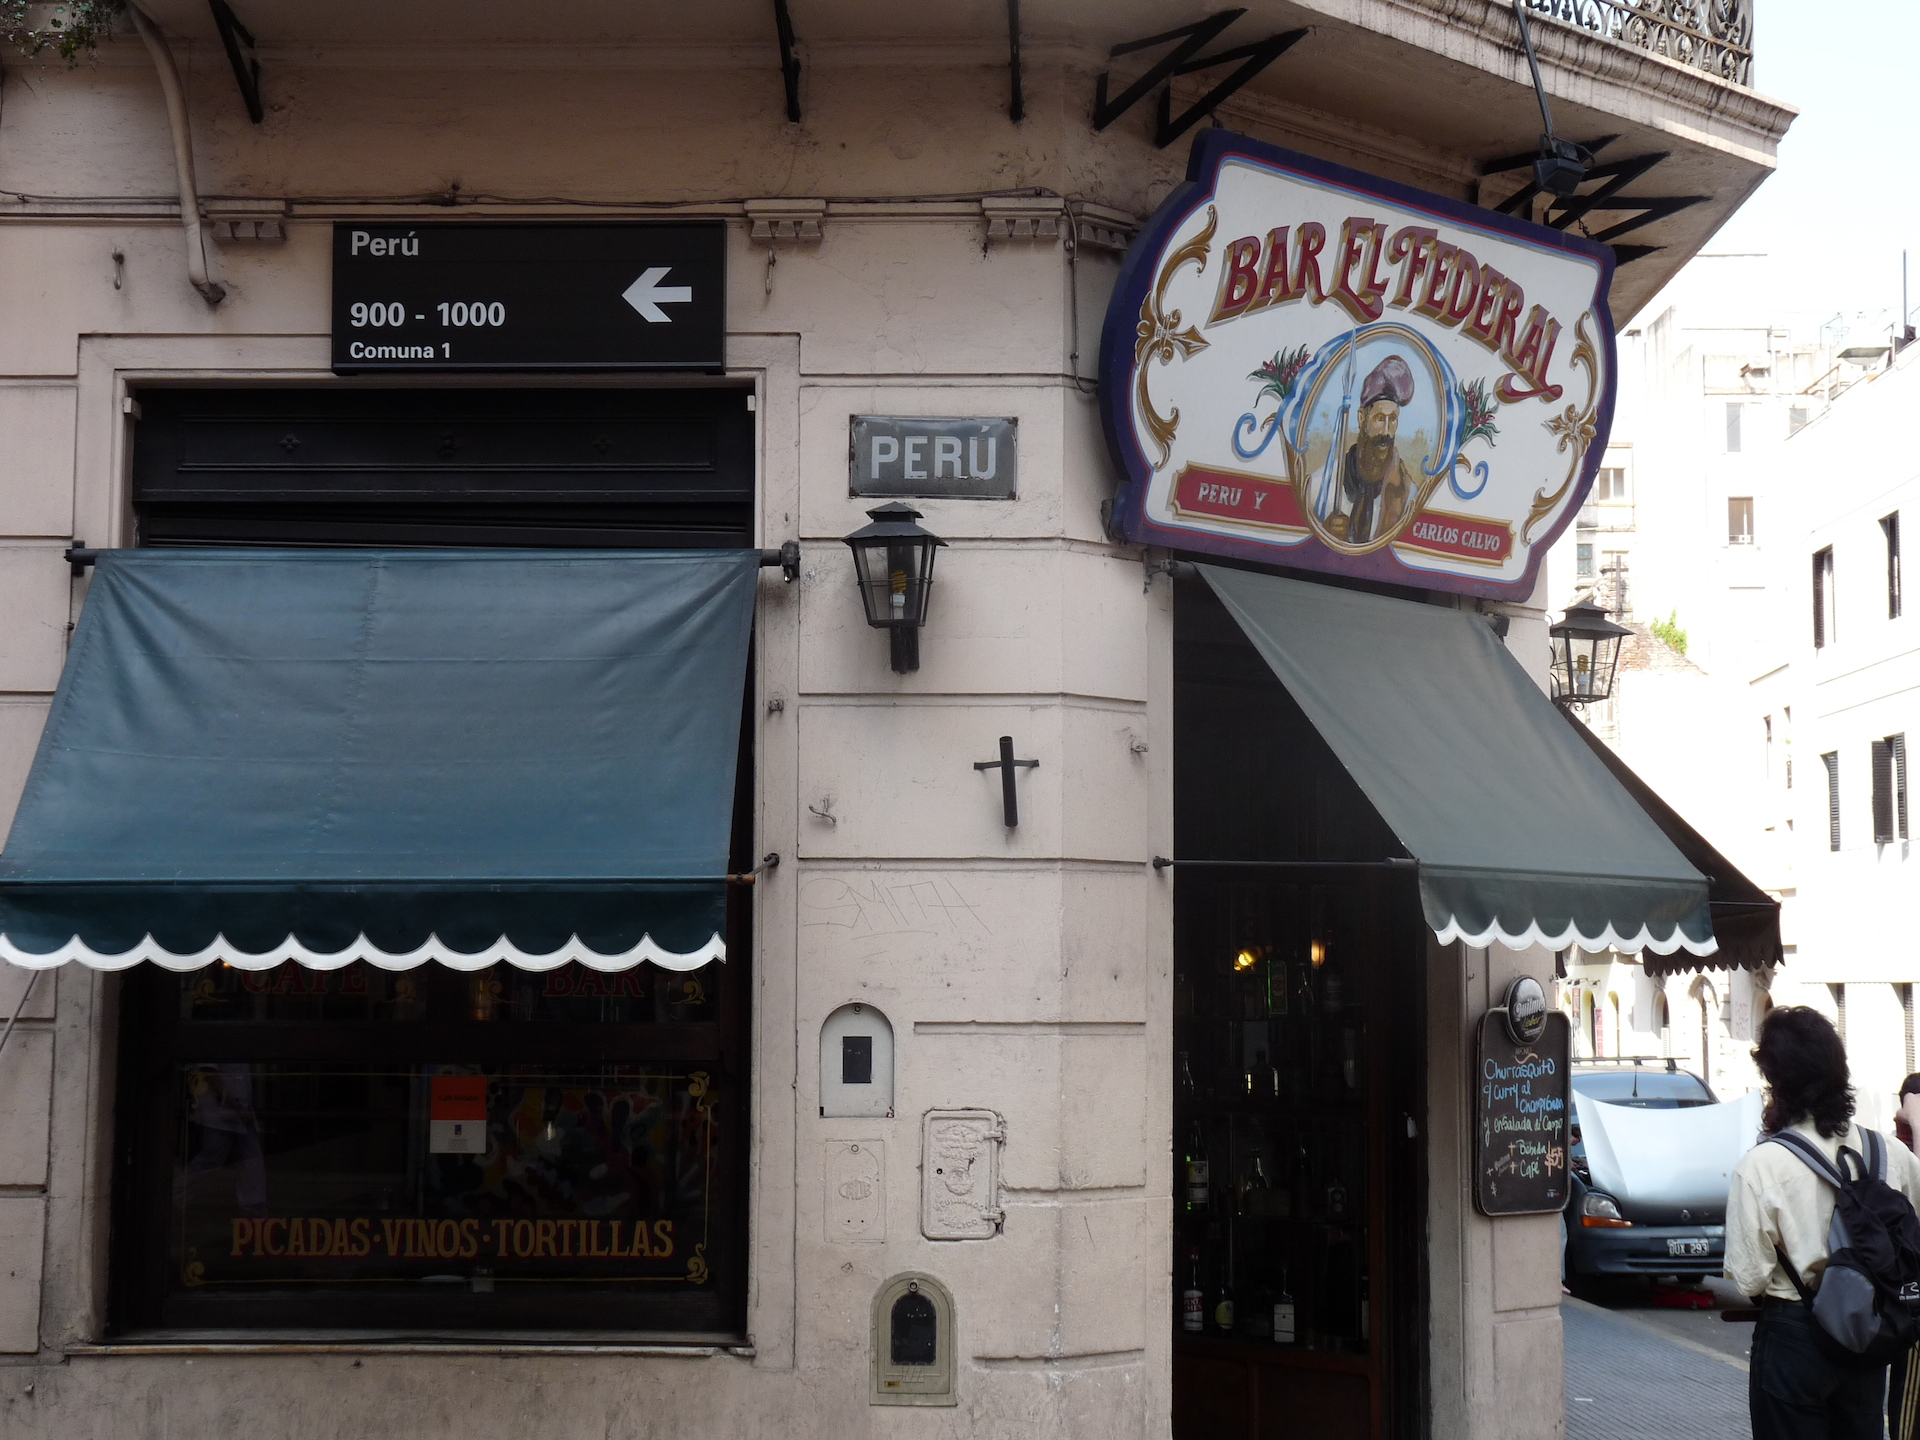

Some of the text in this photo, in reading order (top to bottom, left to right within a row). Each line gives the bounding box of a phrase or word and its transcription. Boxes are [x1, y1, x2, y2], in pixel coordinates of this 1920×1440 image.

[351, 231, 419, 256] Perú
[350, 302, 405, 327] 900
[437, 302, 506, 327] 1000
[1205, 217, 1563, 403] BAR EL FEDERAL
[350, 342, 451, 359] Comuna 1
[871, 425, 997, 481] PERÚ
[1197, 482, 1269, 511] PERU Y
[1411, 521, 1501, 552] CARLOS CALVO
[543, 962, 645, 997] BAR
[1521, 1079, 1531, 1095] al
[230, 1218, 674, 1258] PICADAS VINOS TORTILLAS
